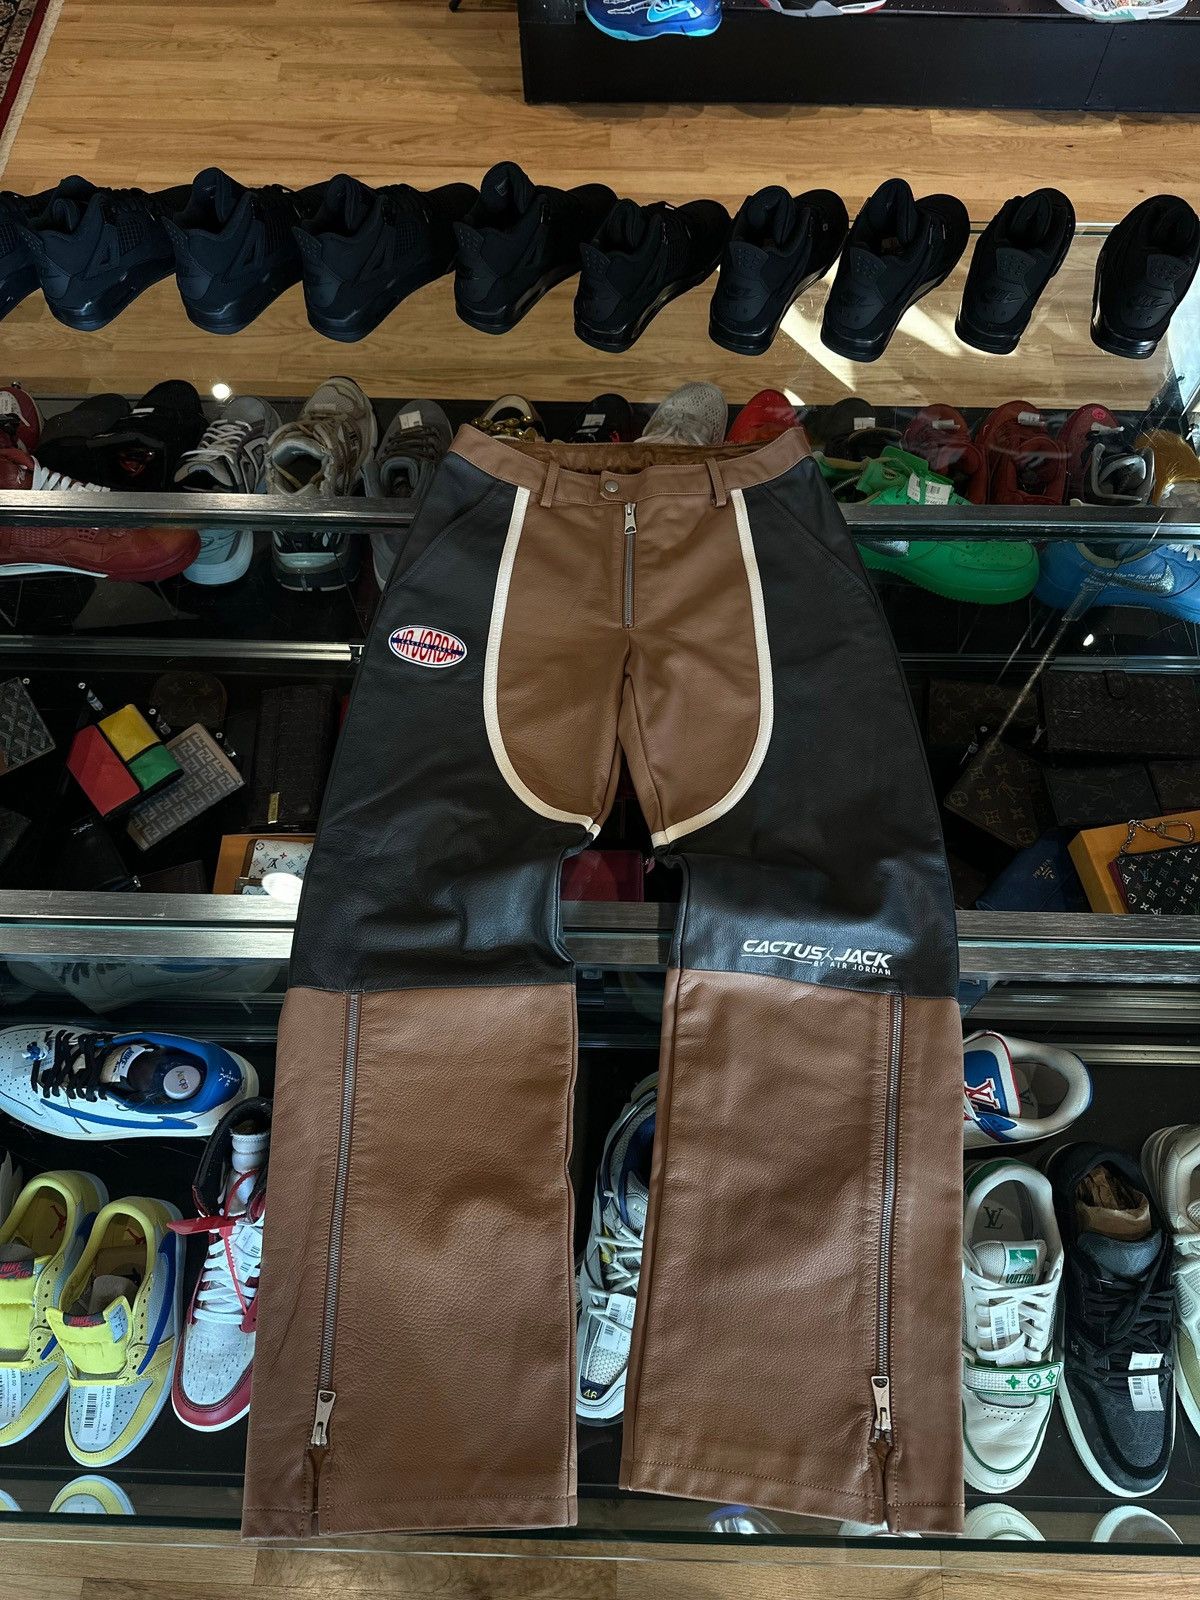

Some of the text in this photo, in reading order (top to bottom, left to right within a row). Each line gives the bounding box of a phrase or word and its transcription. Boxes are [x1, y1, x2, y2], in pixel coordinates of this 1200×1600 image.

[412, 629, 463, 663] JORDAN
[742, 939, 893, 969] CACTUS JACK
[812, 960, 892, 976] BY AIR JORDAN
[583, 1389, 598, 1400] 46
